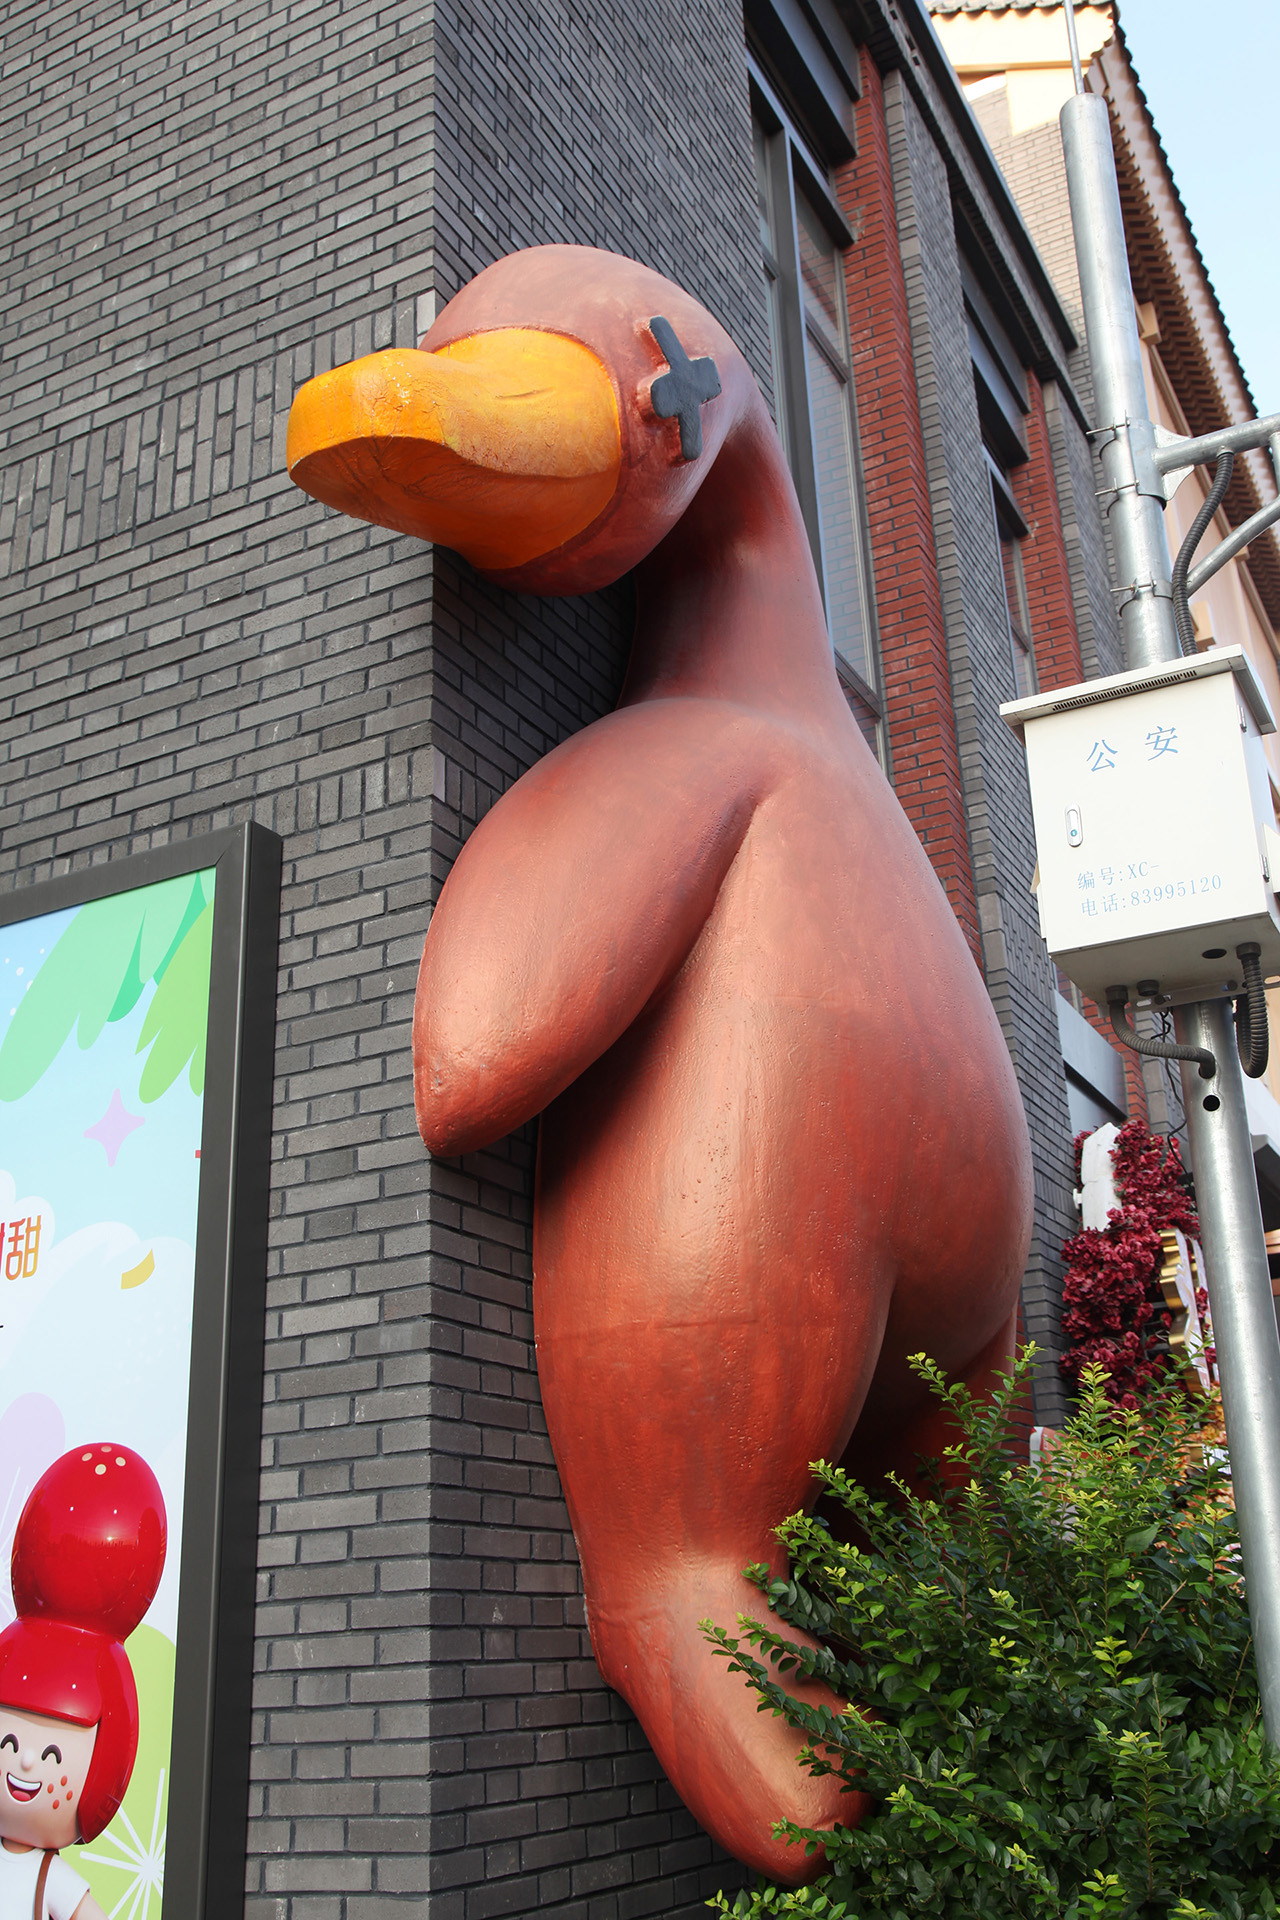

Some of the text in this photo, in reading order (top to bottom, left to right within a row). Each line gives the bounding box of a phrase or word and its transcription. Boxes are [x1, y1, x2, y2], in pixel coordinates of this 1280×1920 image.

[1086, 726, 1178, 772] 公安
[1081, 874, 1222, 917] 电话:83995120
[0, 1215, 42, 1281] 甜
